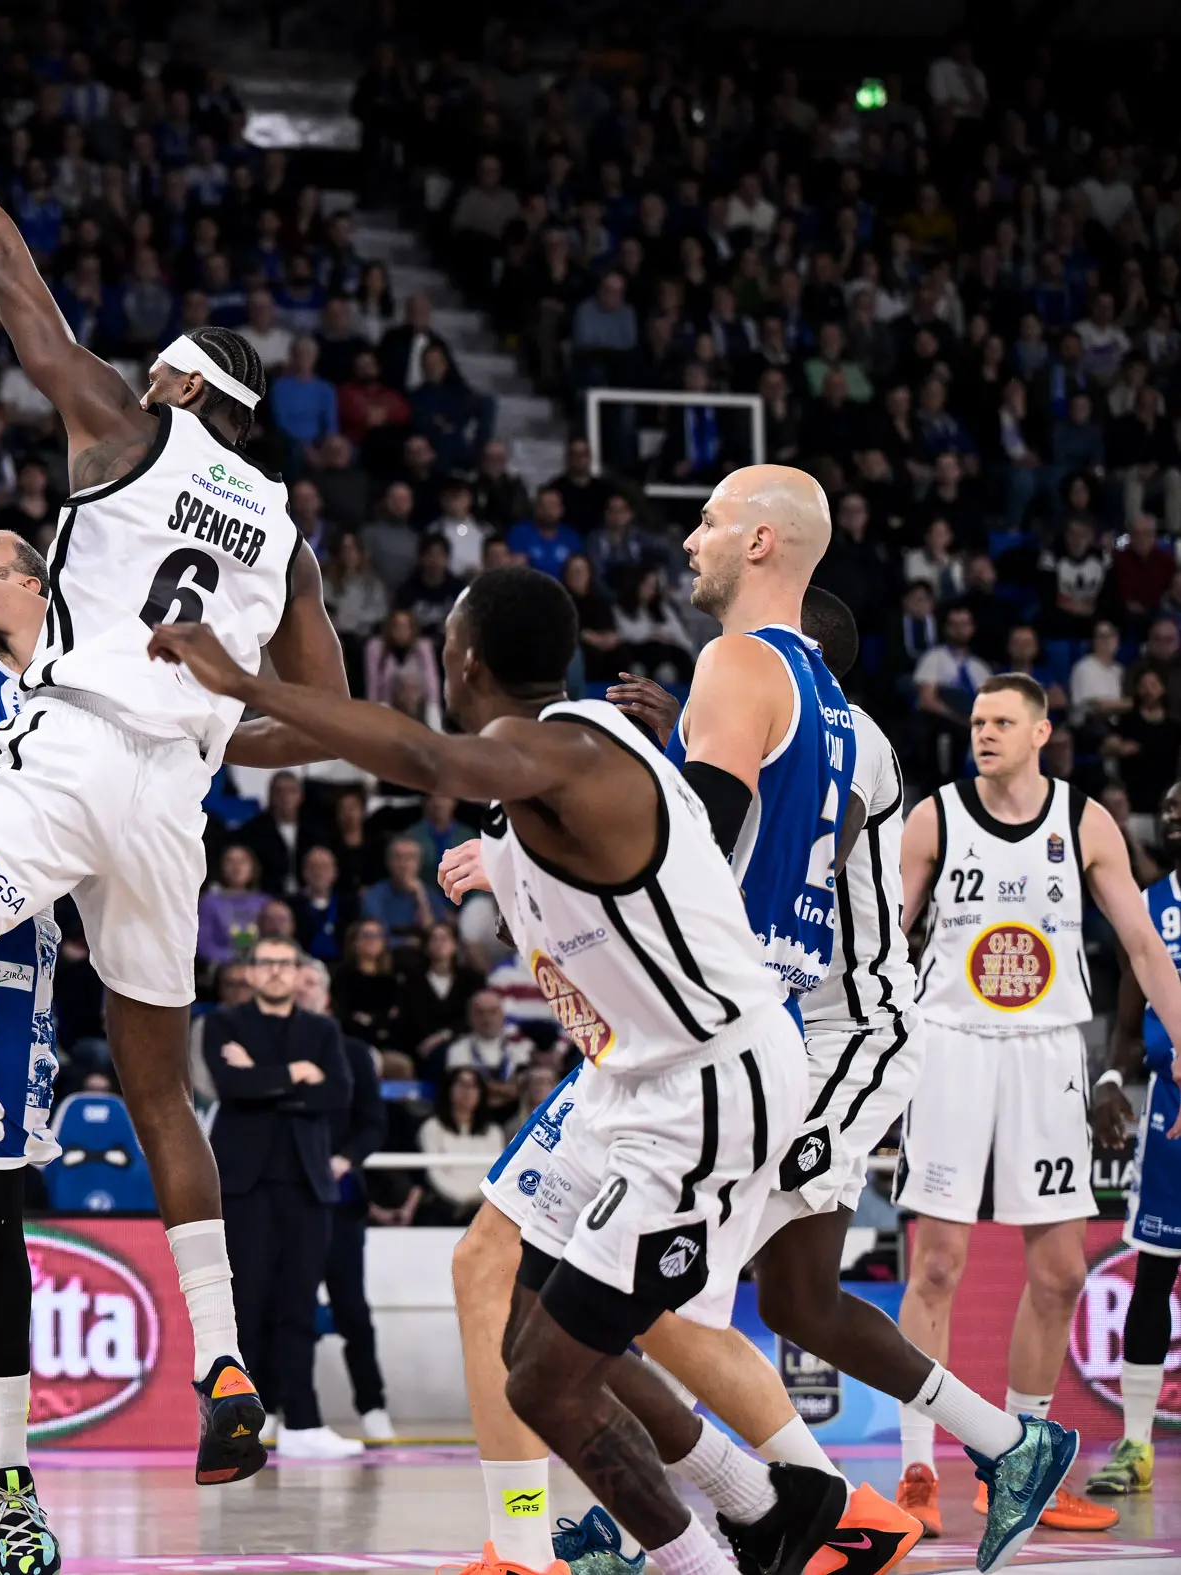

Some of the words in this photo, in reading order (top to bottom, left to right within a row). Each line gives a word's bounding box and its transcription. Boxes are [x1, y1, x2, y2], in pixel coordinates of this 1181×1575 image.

[191, 473, 266, 516] CREDIFRIULI
[228, 476, 253, 492] BCC
[168, 490, 266, 567] SPENCER
[138, 547, 220, 632] 6
[950, 868, 984, 904] 22
[998, 880, 1027, 895] SKY
[988, 932, 1034, 955] OLD
[3, 969, 31, 983] ZIRONI
[982, 954, 1040, 976] WILD
[979, 975, 1043, 998] WEST
[1034, 1157, 1076, 1197] 22
[587, 1176, 628, 1231] 0
[674, 1236, 701, 1254] APU
[510, 1503, 540, 1513] PRS
